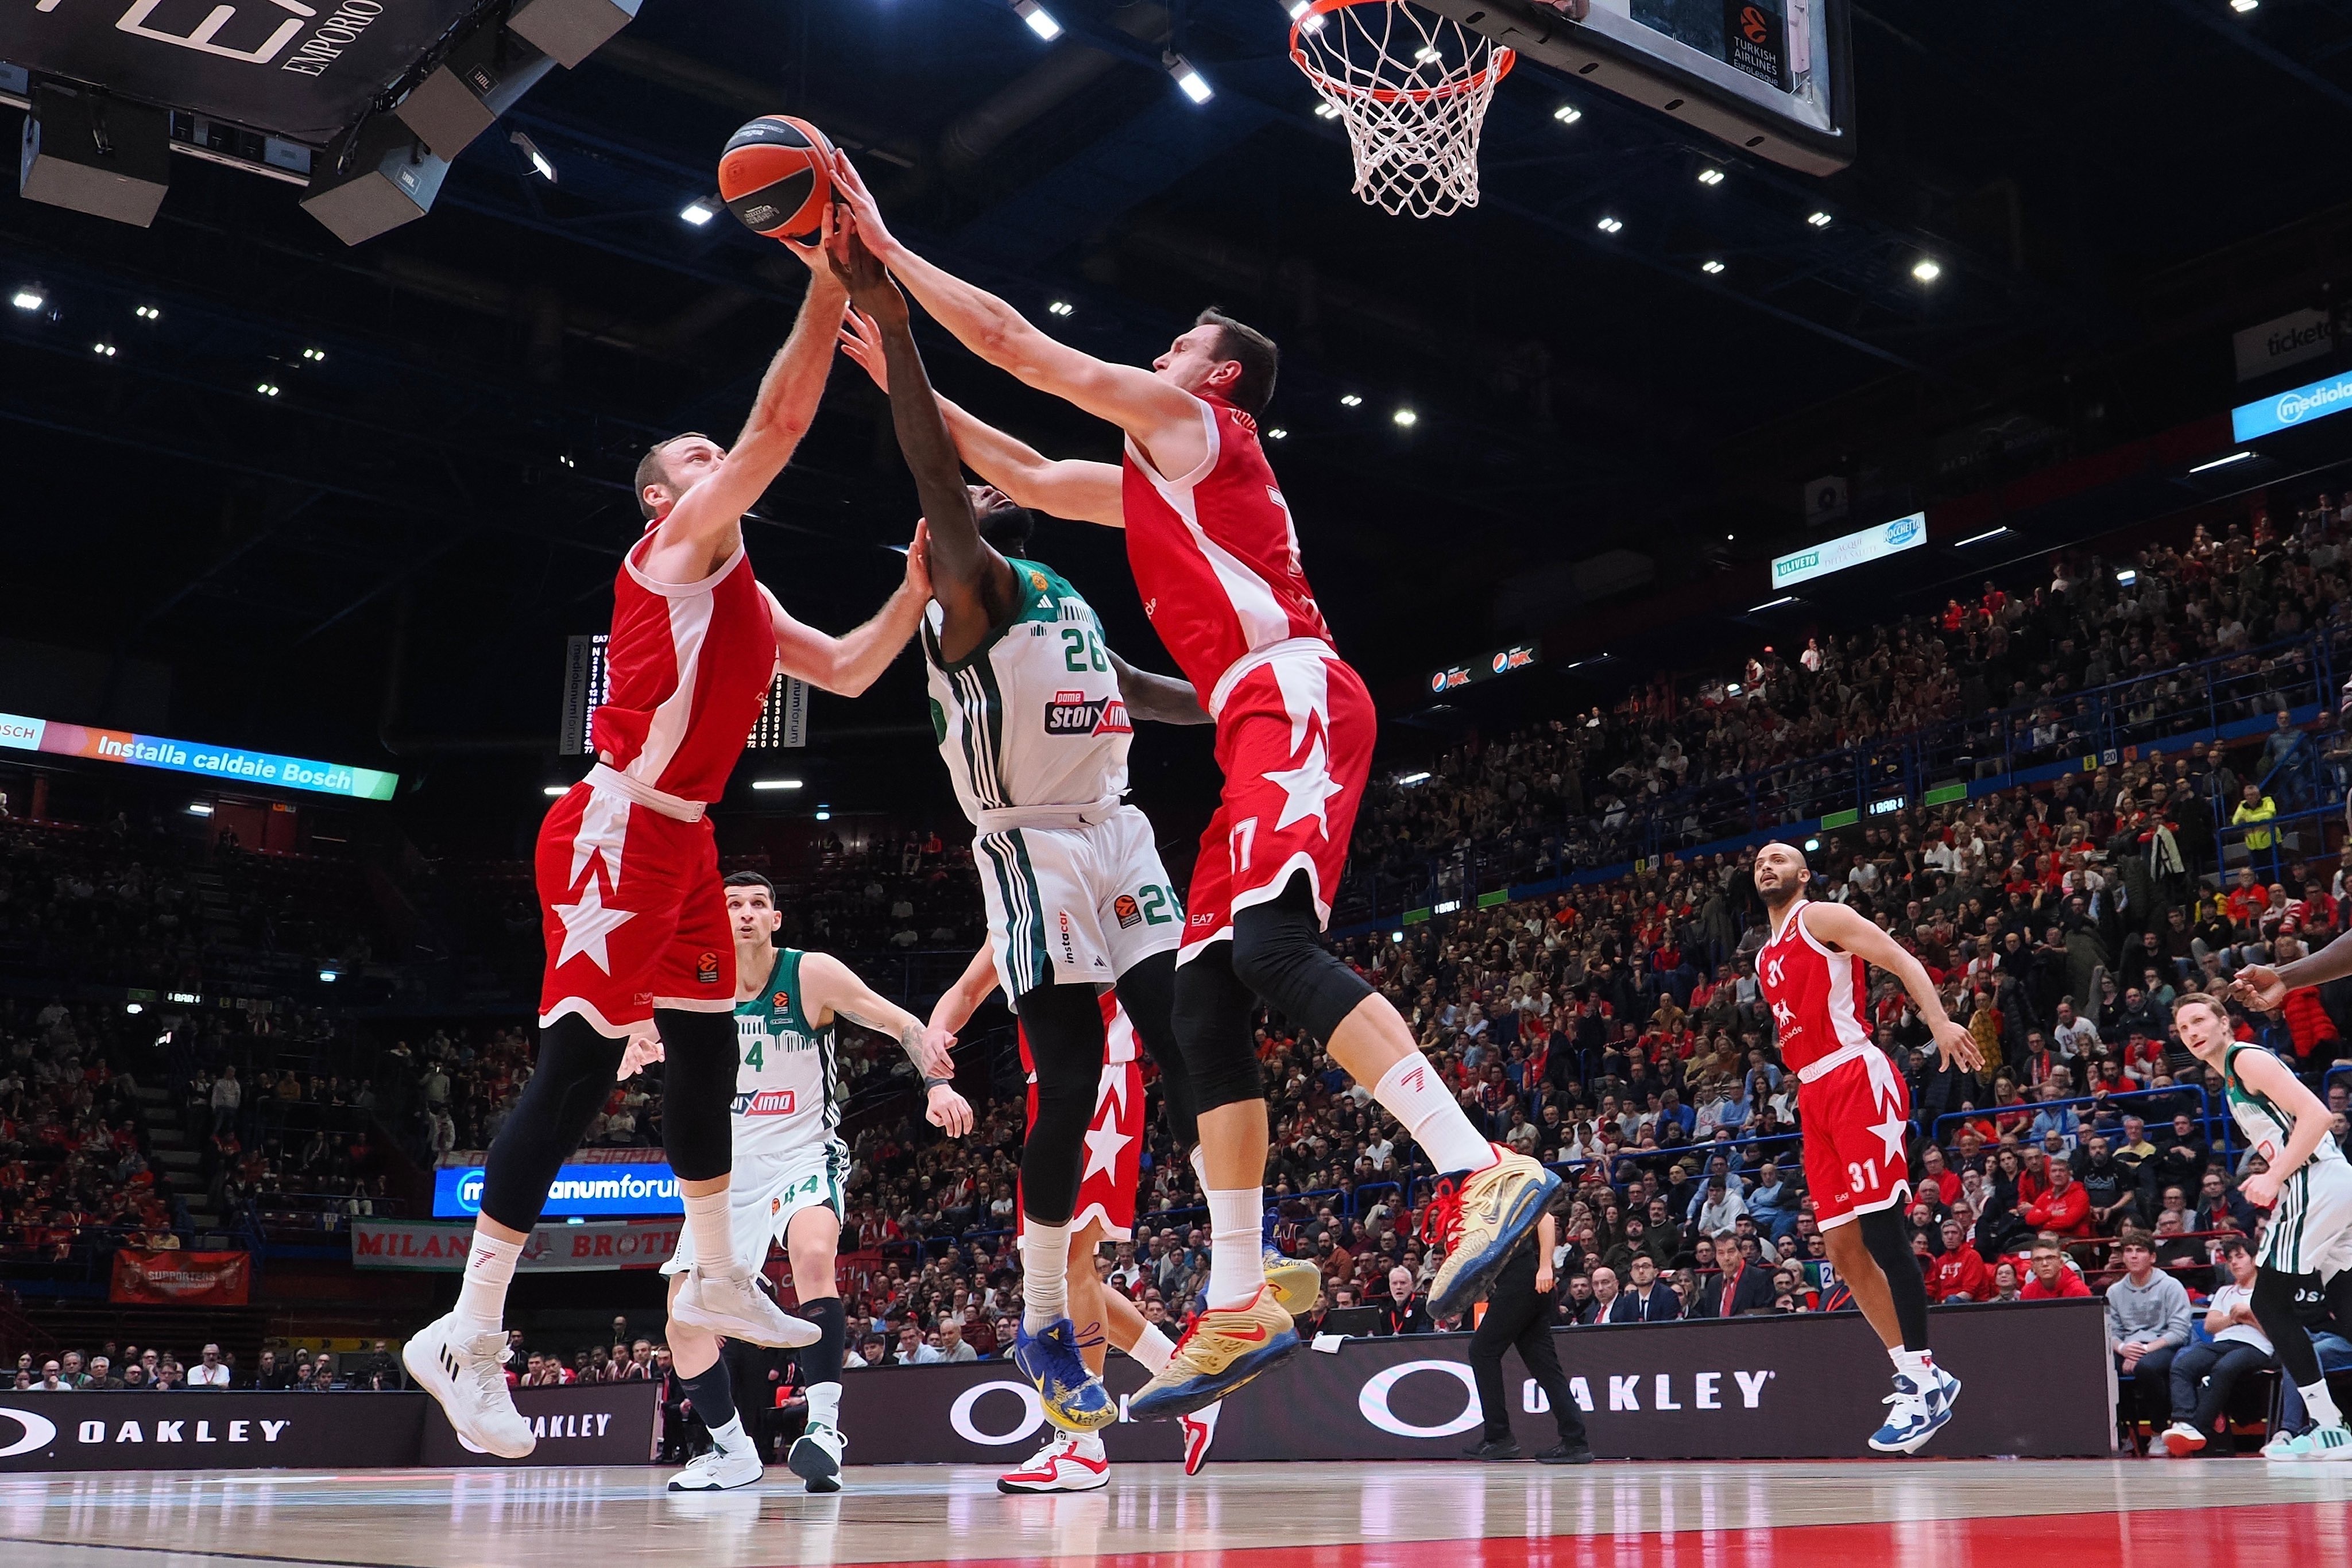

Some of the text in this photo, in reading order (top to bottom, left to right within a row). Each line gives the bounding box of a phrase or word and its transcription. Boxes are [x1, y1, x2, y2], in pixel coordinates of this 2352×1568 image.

[281, 0, 384, 78] EMPORIO
[1734, 36, 1776, 64] TURKISH
[1734, 49, 1777, 75] AIRLINES
[1734, 59, 1778, 86] EuroLeague
[475, 71, 490, 90] JBL
[1883, 518, 1921, 543] ROCCHETTA
[1780, 554, 1817, 575] ULIVETO
[593, 635, 609, 643] EA7
[1061, 628, 1108, 673] 26
[790, 679, 802, 744] numforum
[0, 724, 36, 740] SCH
[98, 735, 352, 791] Installa caldaie Bosch
[2104, 752, 2117, 764] 20
[1875, 799, 1898, 814] BAR
[1438, 900, 1456, 914] BAR
[1191, 913, 1214, 925] EA7
[1059, 911, 1075, 964] instacar
[174, 993, 195, 1004] BAR
[1848, 1157, 1879, 1193] 31
[148, 1271, 216, 1282] SUPPORTERS
[1523, 1370, 1767, 1413] OAKLEY
[78, 1420, 285, 1442] OAKLEY
